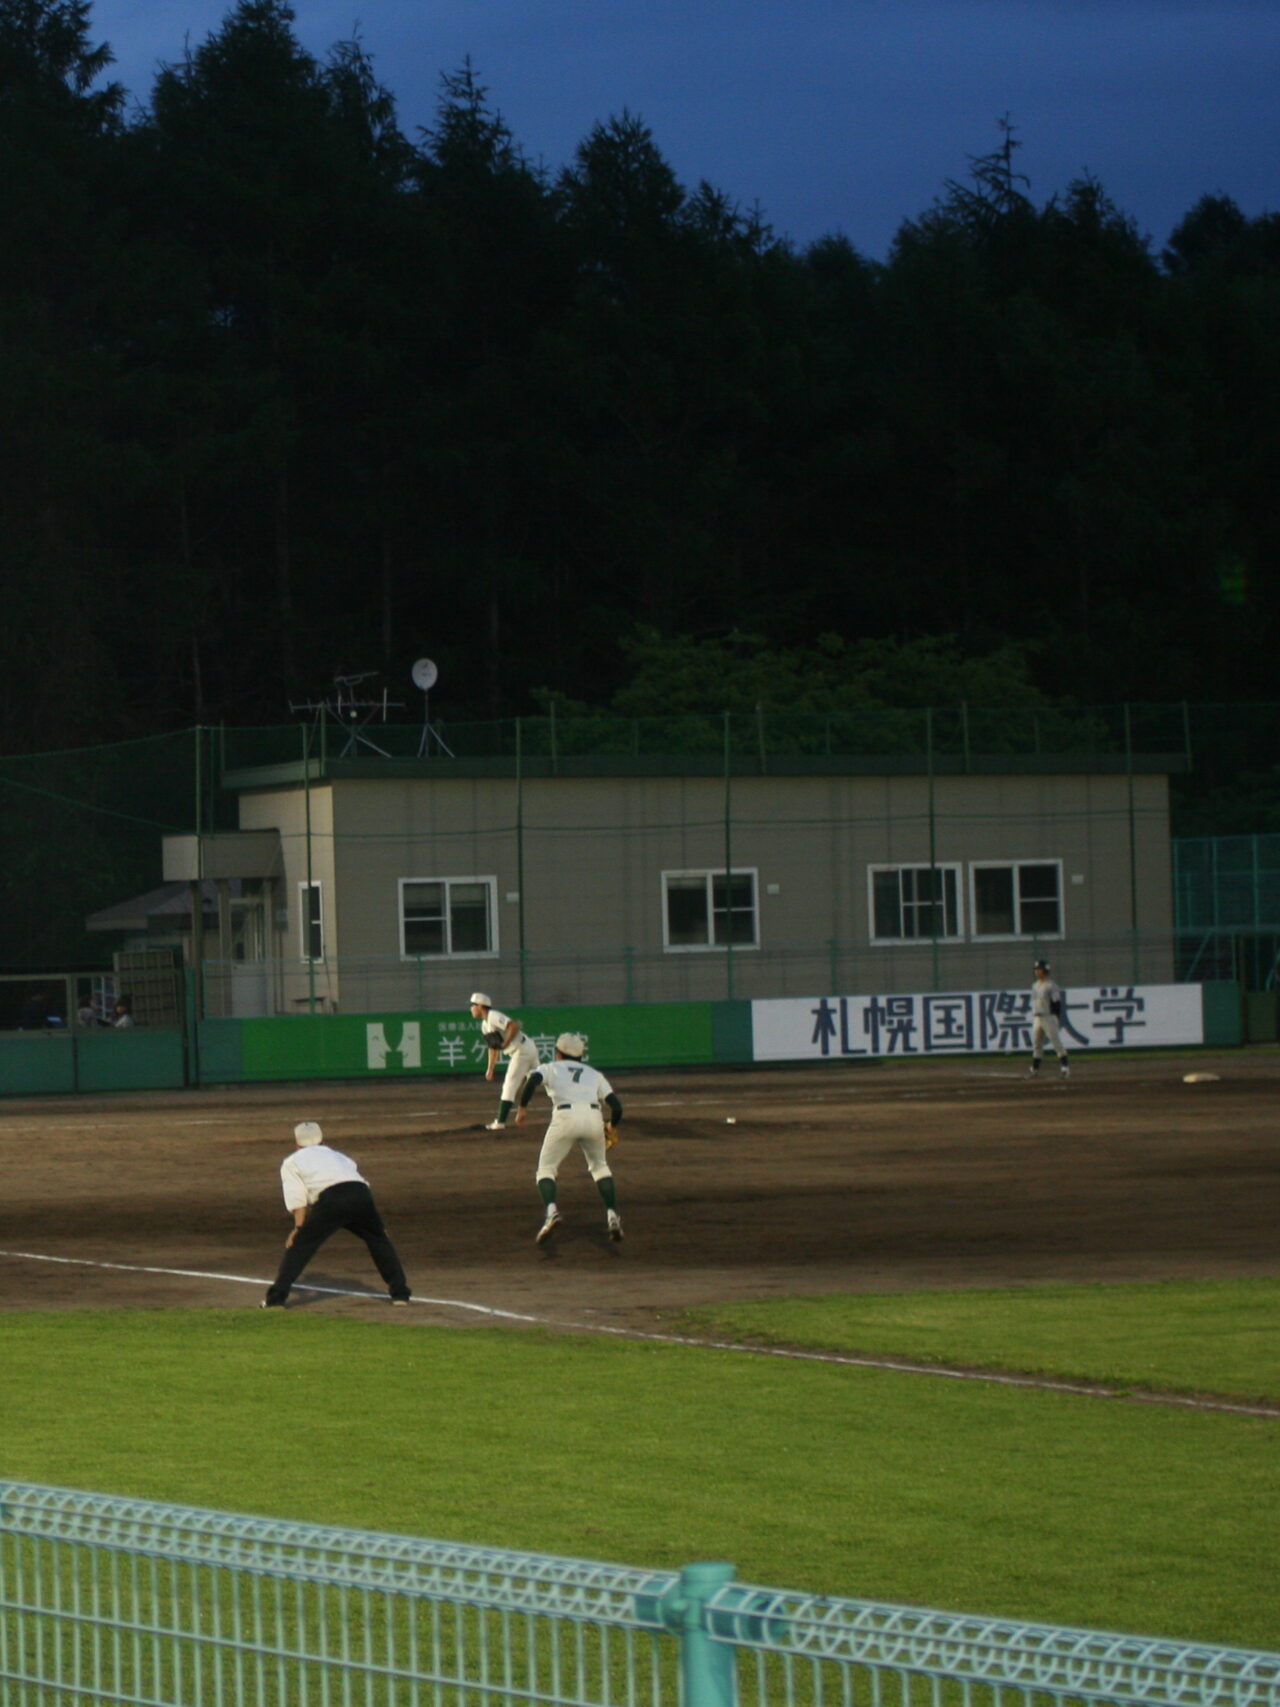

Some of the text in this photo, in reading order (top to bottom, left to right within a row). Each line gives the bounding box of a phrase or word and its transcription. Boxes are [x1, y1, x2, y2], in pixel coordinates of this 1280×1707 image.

[811, 987, 1147, 1056] 札幌国際大学
[567, 1066, 584, 1084] 7
